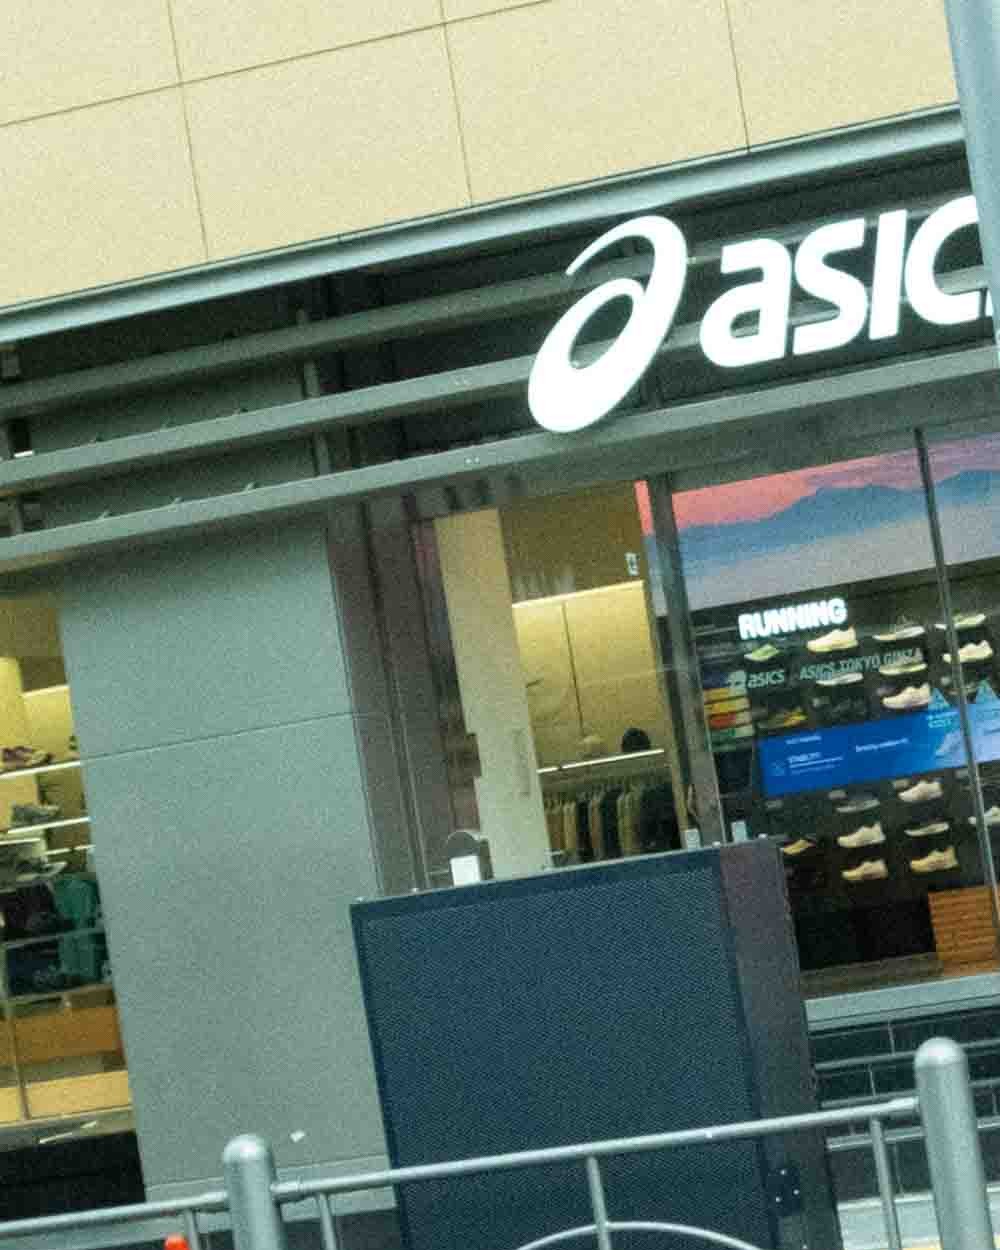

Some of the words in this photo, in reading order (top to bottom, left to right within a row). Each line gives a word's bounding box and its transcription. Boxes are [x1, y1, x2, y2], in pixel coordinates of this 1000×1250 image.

[700, 194, 995, 368] asic
[738, 597, 848, 640] RUNNING
[839, 654, 881, 673] TOKYO
